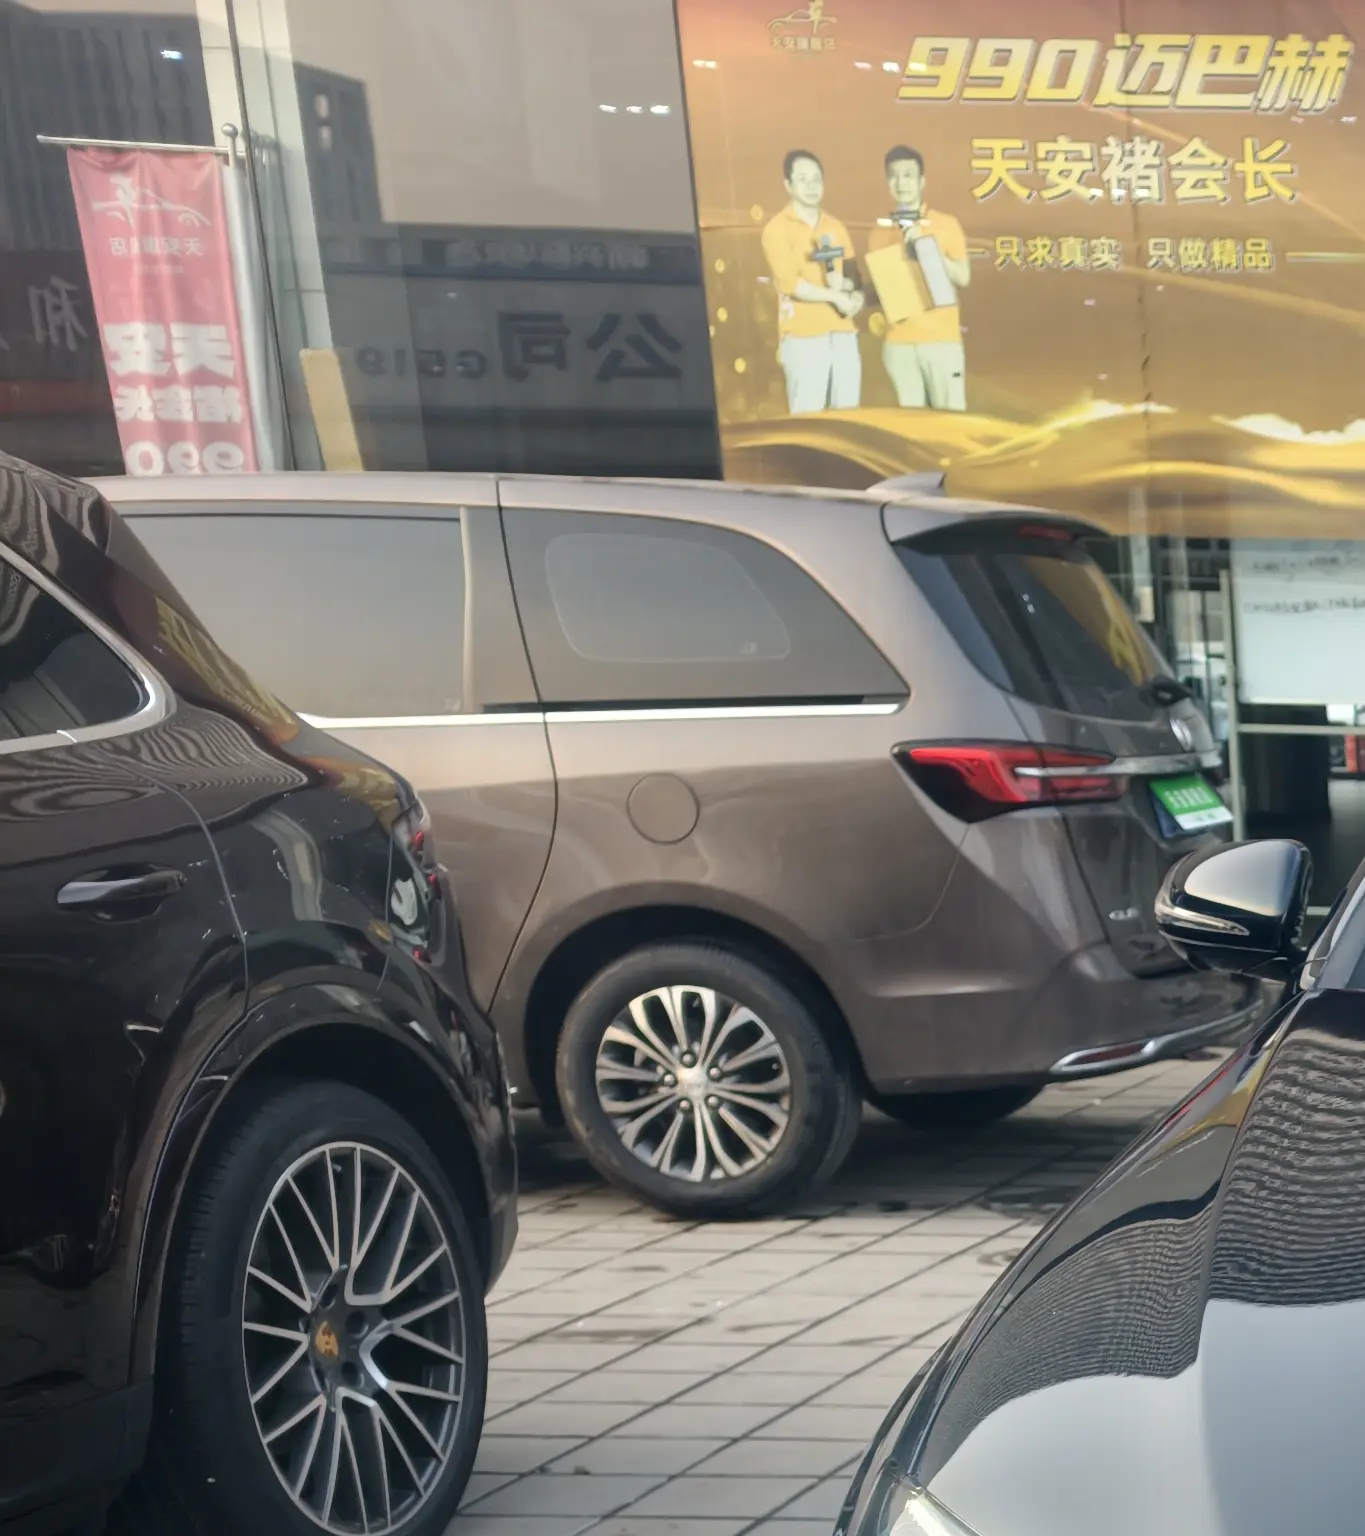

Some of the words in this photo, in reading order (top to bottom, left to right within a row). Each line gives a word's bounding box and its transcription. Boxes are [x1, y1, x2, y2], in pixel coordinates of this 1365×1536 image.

[898, 33, 1357, 112] 990迈巴赫
[970, 136, 1297, 203] 天安褚会长
[993, 236, 1123, 270] 只求真实
[1147, 236, 1276, 271] 只做精品
